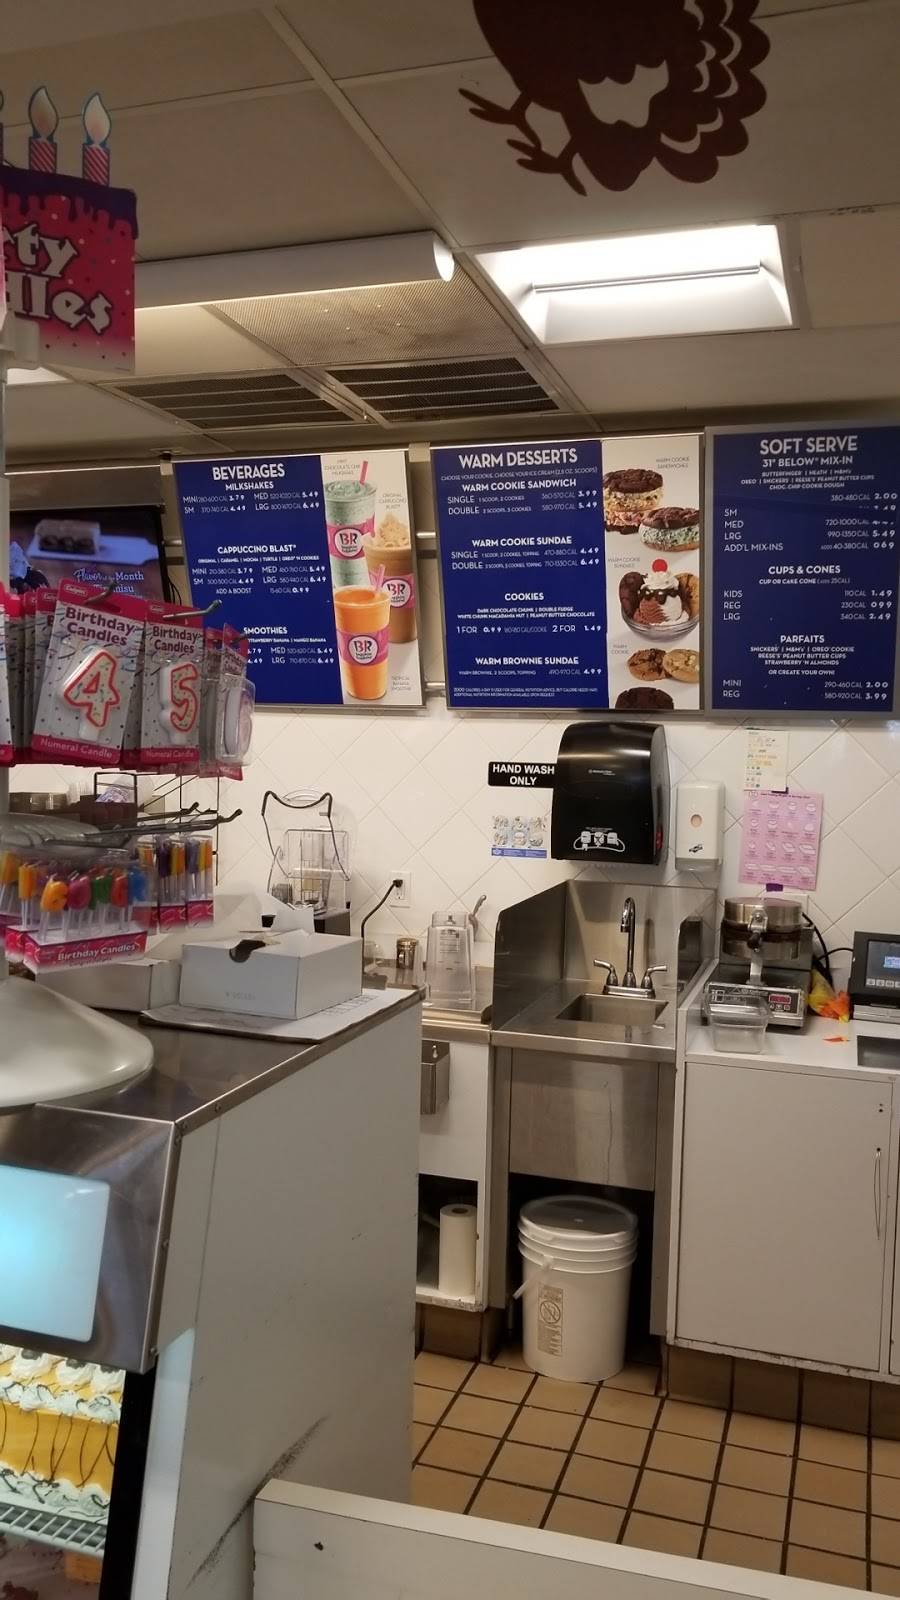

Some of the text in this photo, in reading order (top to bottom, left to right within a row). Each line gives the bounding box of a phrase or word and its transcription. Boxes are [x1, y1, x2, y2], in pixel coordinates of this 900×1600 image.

[760, 436, 858, 455] SOFT SERVE
[459, 448, 578, 469] WARM DESSERTS
[820, 456, 853, 465] MIX-IN
[212, 464, 285, 480] BEVERAGES
[226, 482, 274, 491] MILKSHAKES
[462, 479, 576, 492] WARM COOKIE SANDWICH
[254, 492, 268, 500] MED
[448, 495, 475, 504] SINGLE
[255, 502, 269, 510] LRG
[448, 506, 480, 515] DOUBLE
[724, 508, 737, 517] SM
[340, 533, 358, 545] BR
[724, 532, 742, 540] LRG
[472, 536, 572, 547] WARM COOKIE SUNDAE
[218, 545, 268, 554] CAPPUCCINO
[752, 543, 784, 551] MIX-INS
[451, 551, 478, 559] SINGLE
[452, 562, 483, 570] DOUBLE
[768, 565, 841, 575] CUPS & CONES
[115, 571, 144, 580] Month
[505, 592, 544, 601] COOKIES
[724, 590, 742, 598] KIDS
[724, 602, 741, 610] REG
[724, 612, 740, 621] LRG
[65, 607, 136, 637] Birthday
[243, 626, 288, 635] SMOOTHIES
[462, 626, 478, 634] FOR
[552, 624, 558, 632] 2
[560, 624, 576, 632] FOR
[67, 622, 128, 646] Candles
[153, 626, 199, 645] Birthday
[780, 635, 825, 643] PARFAITS
[154, 640, 194, 654] Candles
[353, 640, 372, 652] BR
[476, 656, 579, 665] WARM BROWNIE SUNDAE
[64, 648, 120, 728] 4
[170, 662, 198, 732] 5
[40, 738, 112, 760] Numeral Candle
[492, 764, 555, 775] HAND WASH
[510, 776, 537, 786] ONLY
[58, 949, 99, 961] Birthday
[101, 943, 136, 954] Candles
